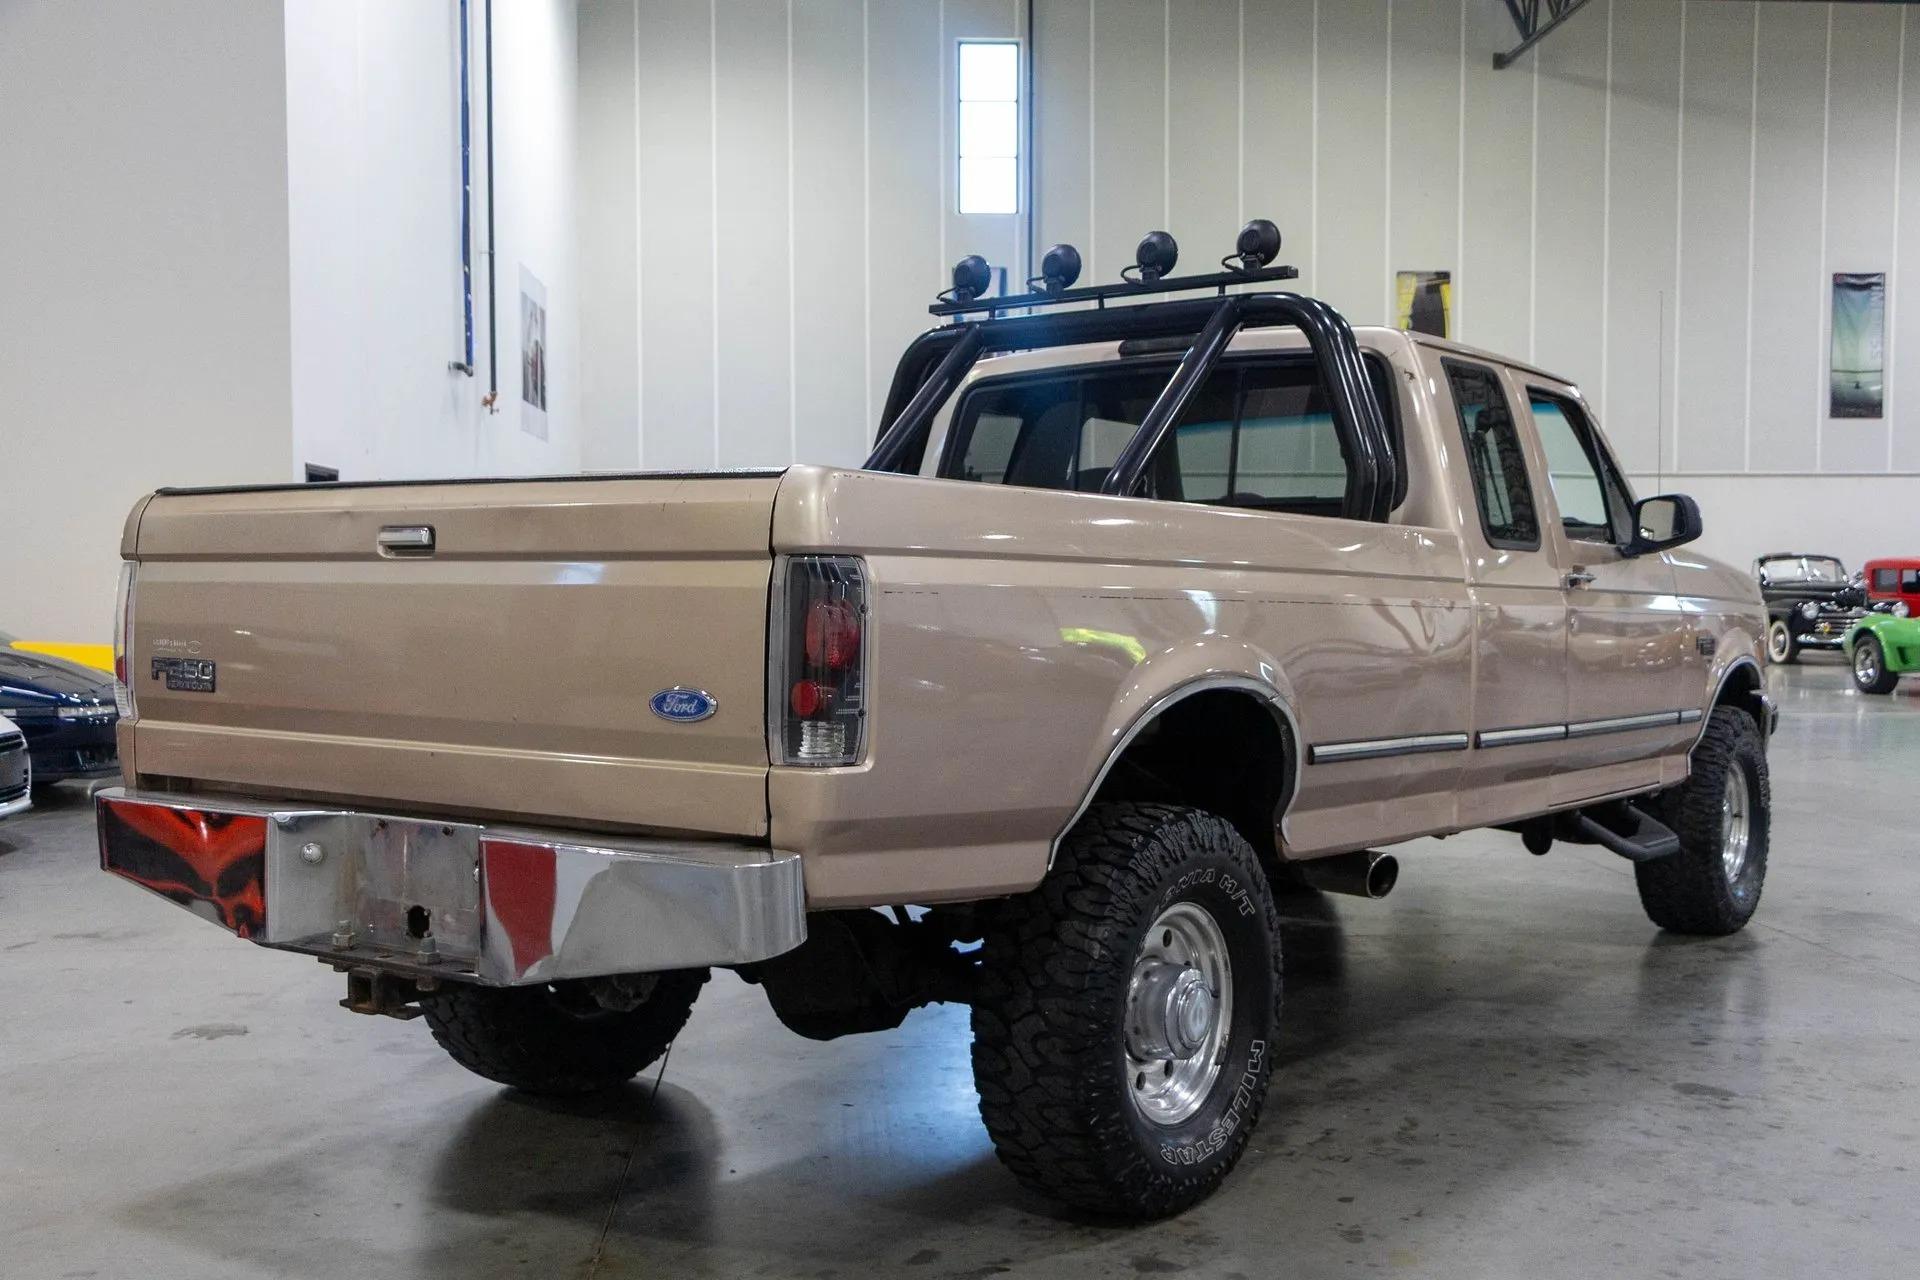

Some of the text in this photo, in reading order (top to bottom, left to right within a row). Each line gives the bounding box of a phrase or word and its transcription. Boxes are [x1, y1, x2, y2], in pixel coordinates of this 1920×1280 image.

[663, 693, 698, 714] Ford
[1219, 873, 1256, 916] M/T
[1160, 1040, 1265, 1165] MILESTAR
